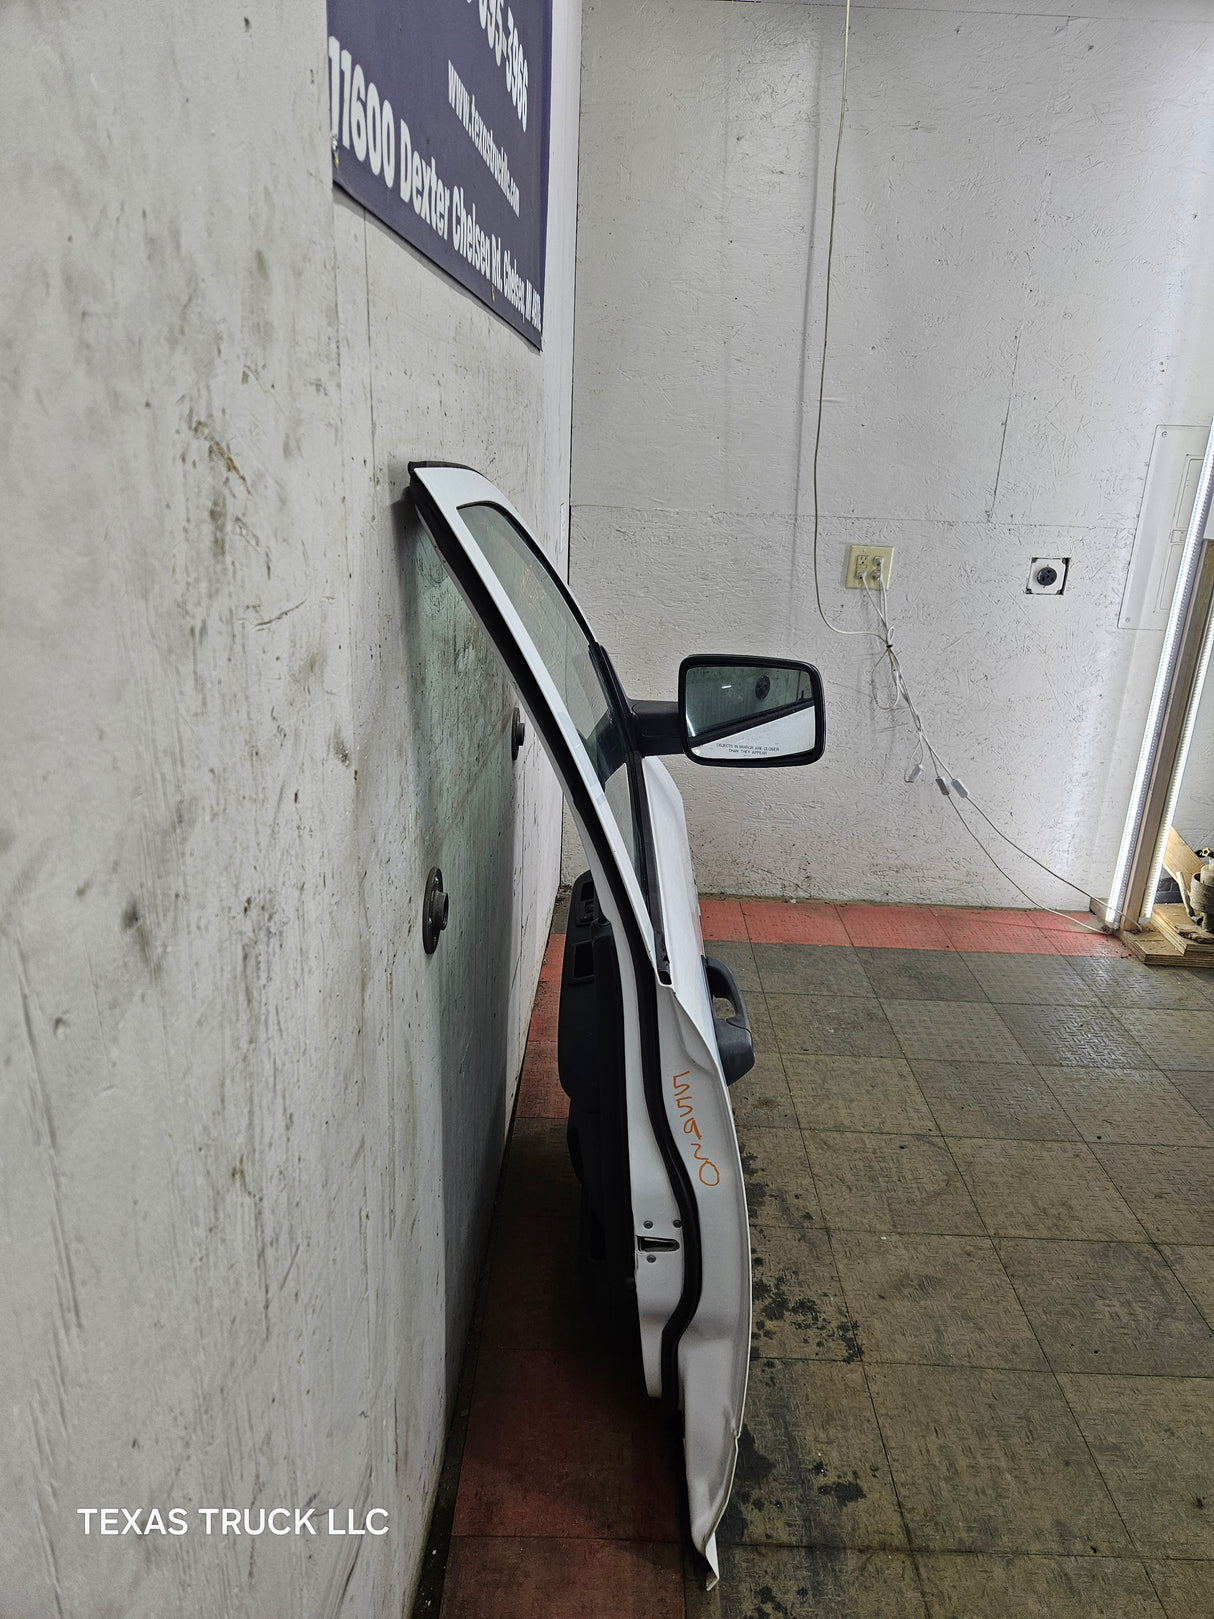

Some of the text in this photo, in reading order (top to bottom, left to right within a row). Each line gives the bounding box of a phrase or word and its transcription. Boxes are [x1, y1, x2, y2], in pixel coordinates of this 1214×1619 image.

[400, 118, 450, 240] Dexter
[452, 184, 491, 281] Chelsea
[491, 233, 503, 293] Rd.
